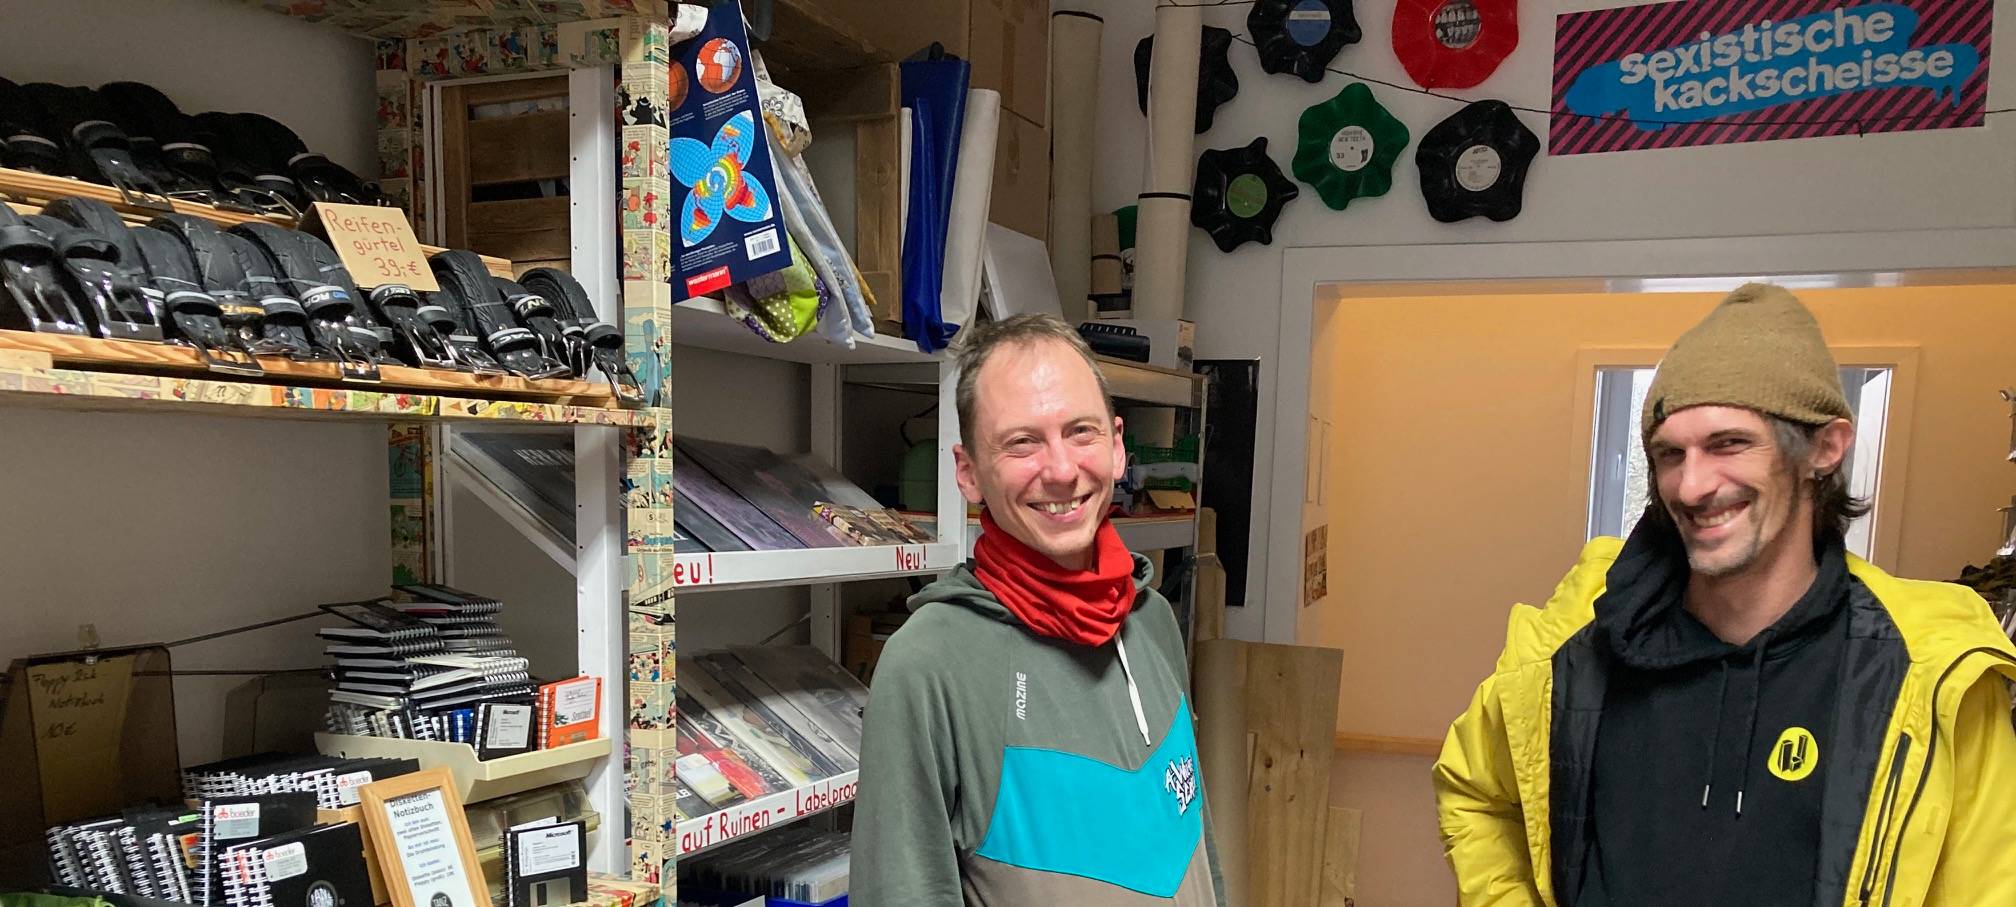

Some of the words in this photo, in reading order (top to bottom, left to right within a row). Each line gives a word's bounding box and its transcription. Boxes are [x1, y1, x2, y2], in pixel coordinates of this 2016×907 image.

[1619, 8, 1896, 84] sexistische
[1653, 47, 1954, 113] kackscheisse
[324, 208, 402, 234] Reifen-
[353, 237, 405, 256] gürtel
[688, 268, 727, 286] westermann
[672, 553, 714, 585] eu!
[895, 546, 927, 571] Neu!
[229, 804, 255, 818] boeder
[393, 801, 435, 818] Notizbuch
[545, 829, 573, 839] Microsoft
[682, 816, 713, 853] auf
[719, 808, 770, 841] Ruinen
